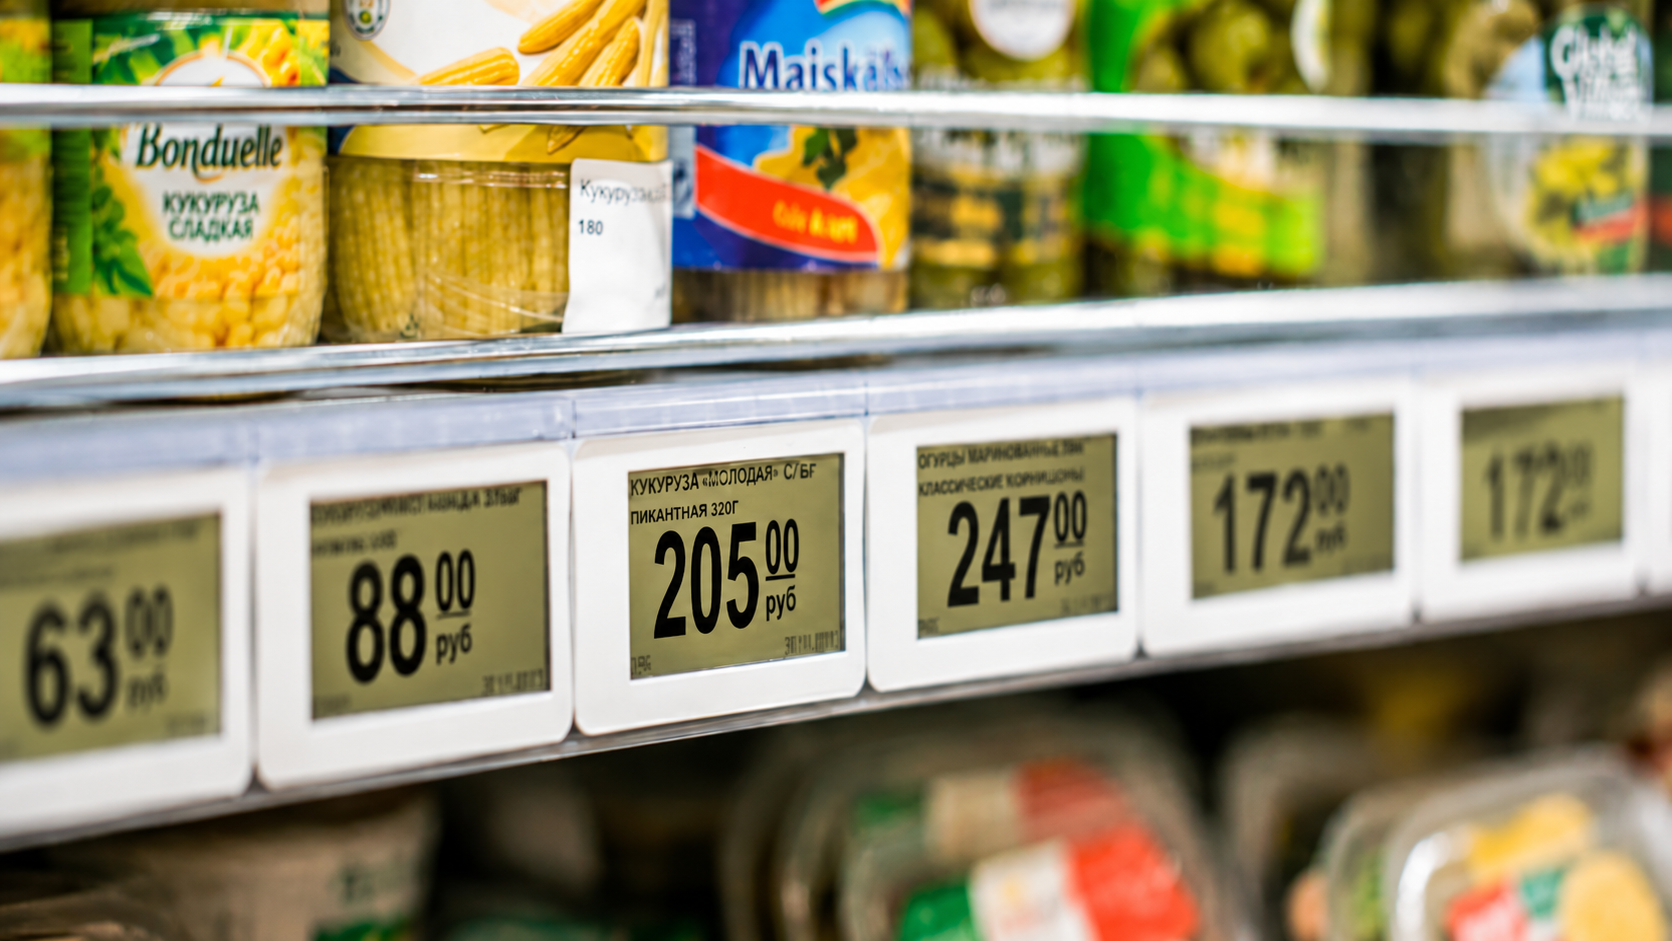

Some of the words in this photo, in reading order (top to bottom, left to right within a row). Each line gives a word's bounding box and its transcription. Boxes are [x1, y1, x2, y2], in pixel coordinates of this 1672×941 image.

[136, 123, 283, 178] Bonduelle
[162, 191, 260, 214] КУКУРУЗА
[169, 217, 253, 242] СЛАДКАЯ
[579, 219, 604, 235] 180
[631, 472, 699, 496] КУКУРУЗА
[631, 503, 707, 525] ПИКАНТНАЯ
[711, 500, 739, 517] 320Г
[1214, 467, 1312, 573] 172
[947, 495, 1050, 608] 247
[1054, 490, 1087, 543] 00
[1054, 551, 1085, 587] руб
[654, 521, 760, 639] 205
[766, 518, 799, 575] 00
[346, 553, 427, 686] 88
[435, 549, 475, 612] 00
[766, 585, 797, 622] руб
[23, 590, 121, 732] 63
[126, 584, 174, 661] 00
[436, 622, 472, 665] руб
